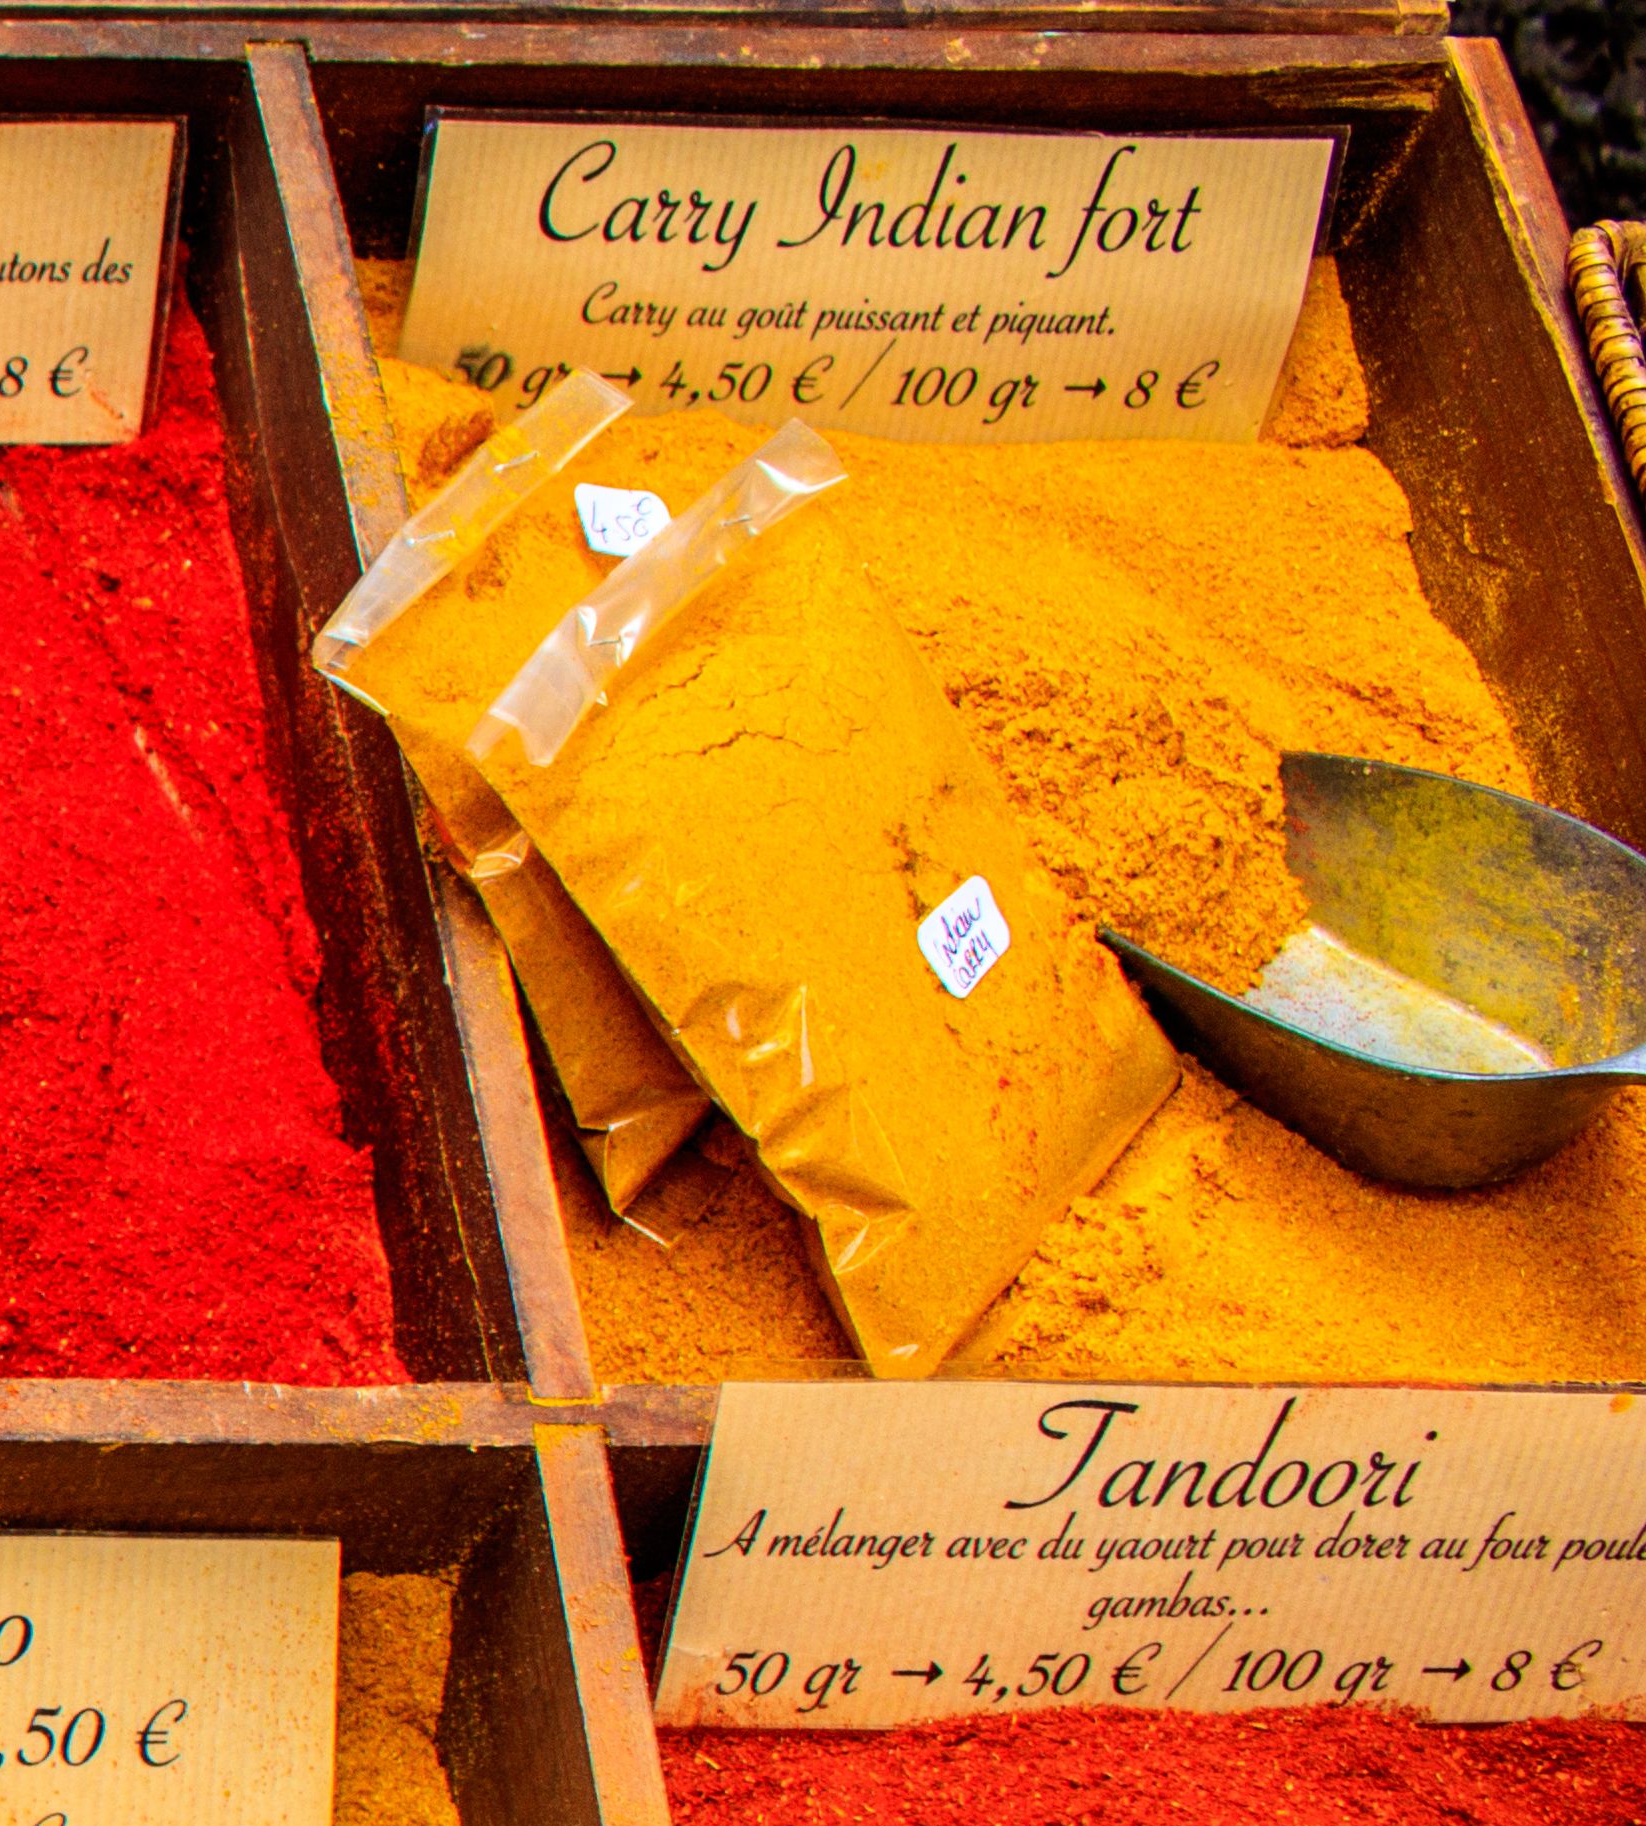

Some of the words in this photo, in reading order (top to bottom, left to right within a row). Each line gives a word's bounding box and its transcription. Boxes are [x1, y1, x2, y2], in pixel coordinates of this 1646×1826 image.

[538, 140, 757, 271] Carry
[778, 144, 1046, 252] Indian
[1045, 145, 1201, 278] fort
[82, 239, 133, 286] des
[581, 282, 677, 333] Carry
[686, 303, 725, 327] au
[736, 299, 806, 333] goût
[811, 299, 942, 333] puissant
[951, 305, 980, 333] et
[984, 303, 1115, 342] piquant.
[47, 346, 89, 396] €
[659, 361, 773, 407] 4,50
[791, 354, 834, 402] €
[897, 367, 978, 407] 100
[990, 374, 1042, 422] gr
[1126, 369, 1158, 408] 8
[1176, 361, 1220, 408] €
[1005, 1398, 1439, 1510] Tandoori
[705, 1508, 758, 1559] A
[767, 1510, 937, 1571] mélanger
[947, 1533, 1027, 1562] avec
[1037, 1512, 1083, 1562] du
[1089, 1530, 1214, 1572] yaourt
[1216, 1530, 1303, 1572] pour
[1314, 1512, 1409, 1562] dorer
[1419, 1535, 1466, 1562] au
[1462, 1514, 1550, 1572] four
[1085, 1571, 1269, 1630] gambas...
[715, 1651, 791, 1696] 50
[805, 1654, 863, 1708] gr
[962, 1653, 1091, 1702] 4,50
[1112, 1643, 1159, 1694] €
[1225, 1649, 1320, 1692] 100
[1337, 1653, 1392, 1704] gr
[1491, 1650, 1532, 1691] 8
[1551, 1639, 1603, 1691] €
[135, 1698, 189, 1768] €
